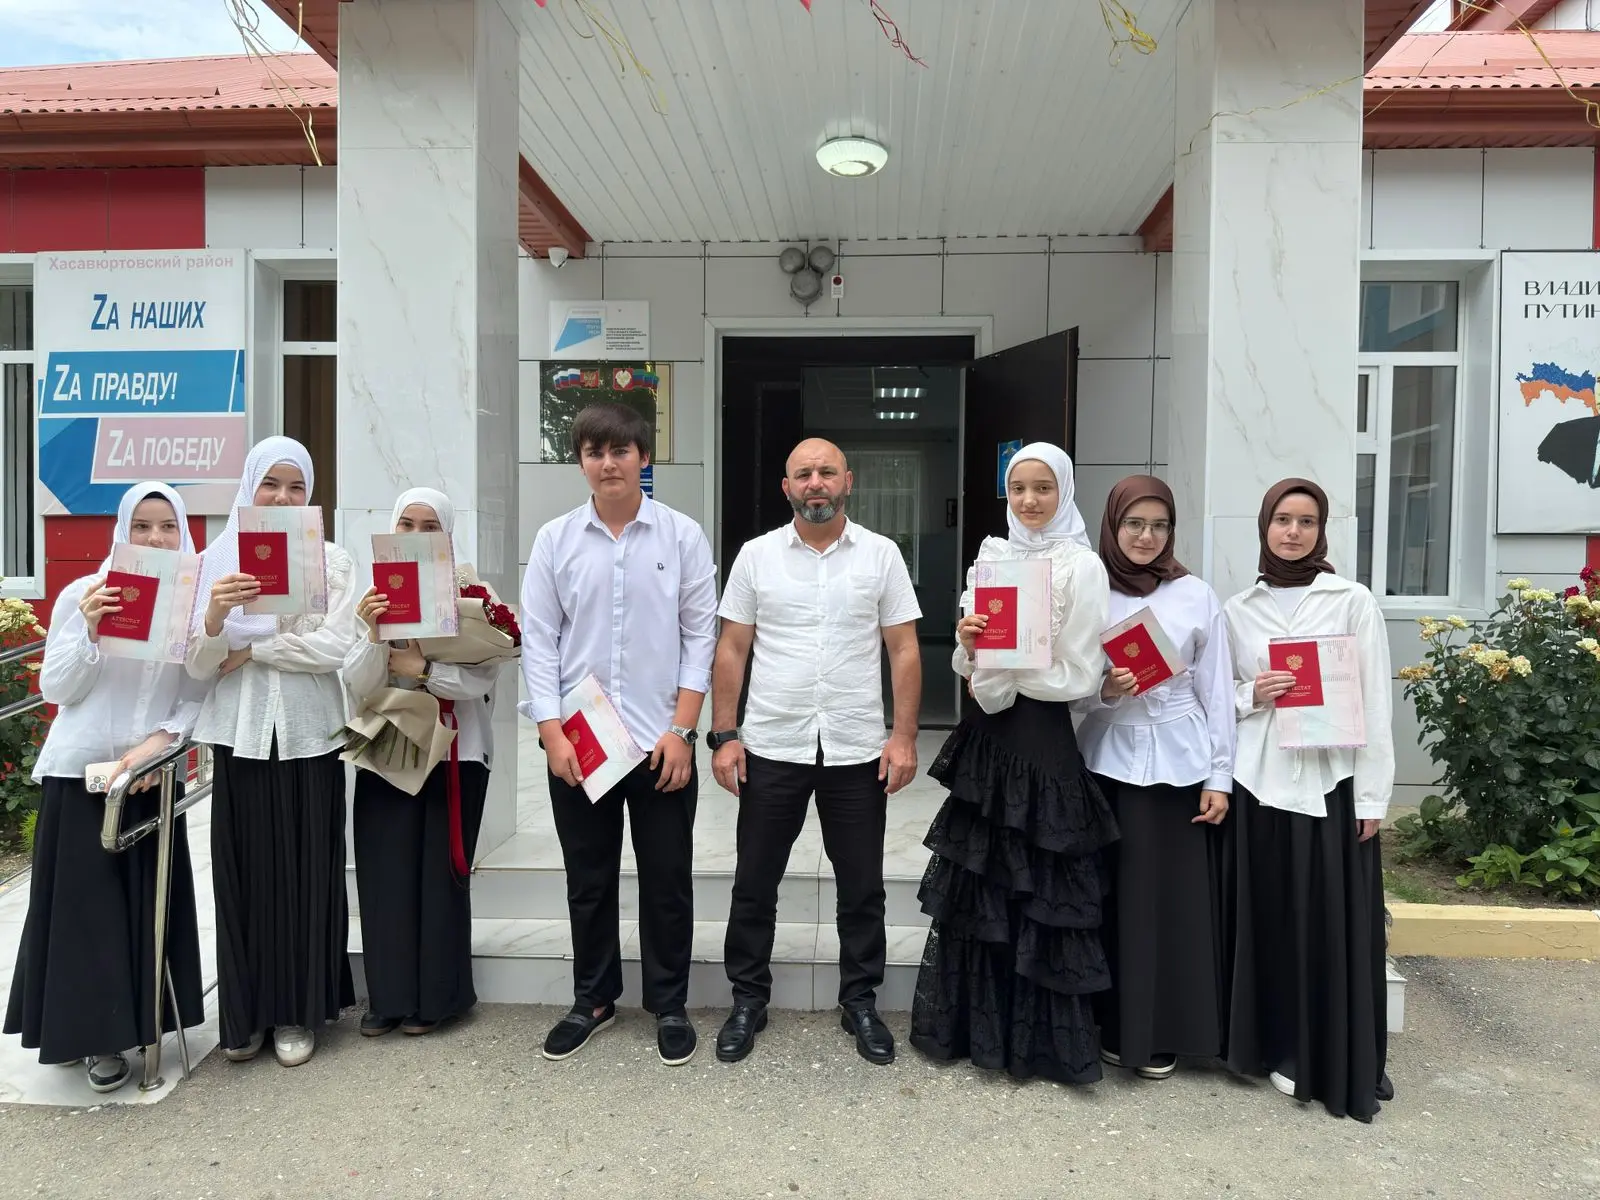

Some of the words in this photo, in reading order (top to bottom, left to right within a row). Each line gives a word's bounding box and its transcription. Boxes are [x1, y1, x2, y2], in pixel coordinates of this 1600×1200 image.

[49, 256, 181, 272] Хасавюртовский
[187, 255, 234, 271] район
[130, 300, 207, 329] НАШИХ
[91, 372, 178, 406] ПРАВДУ!
[140, 437, 226, 471] ПОБЕДУ
